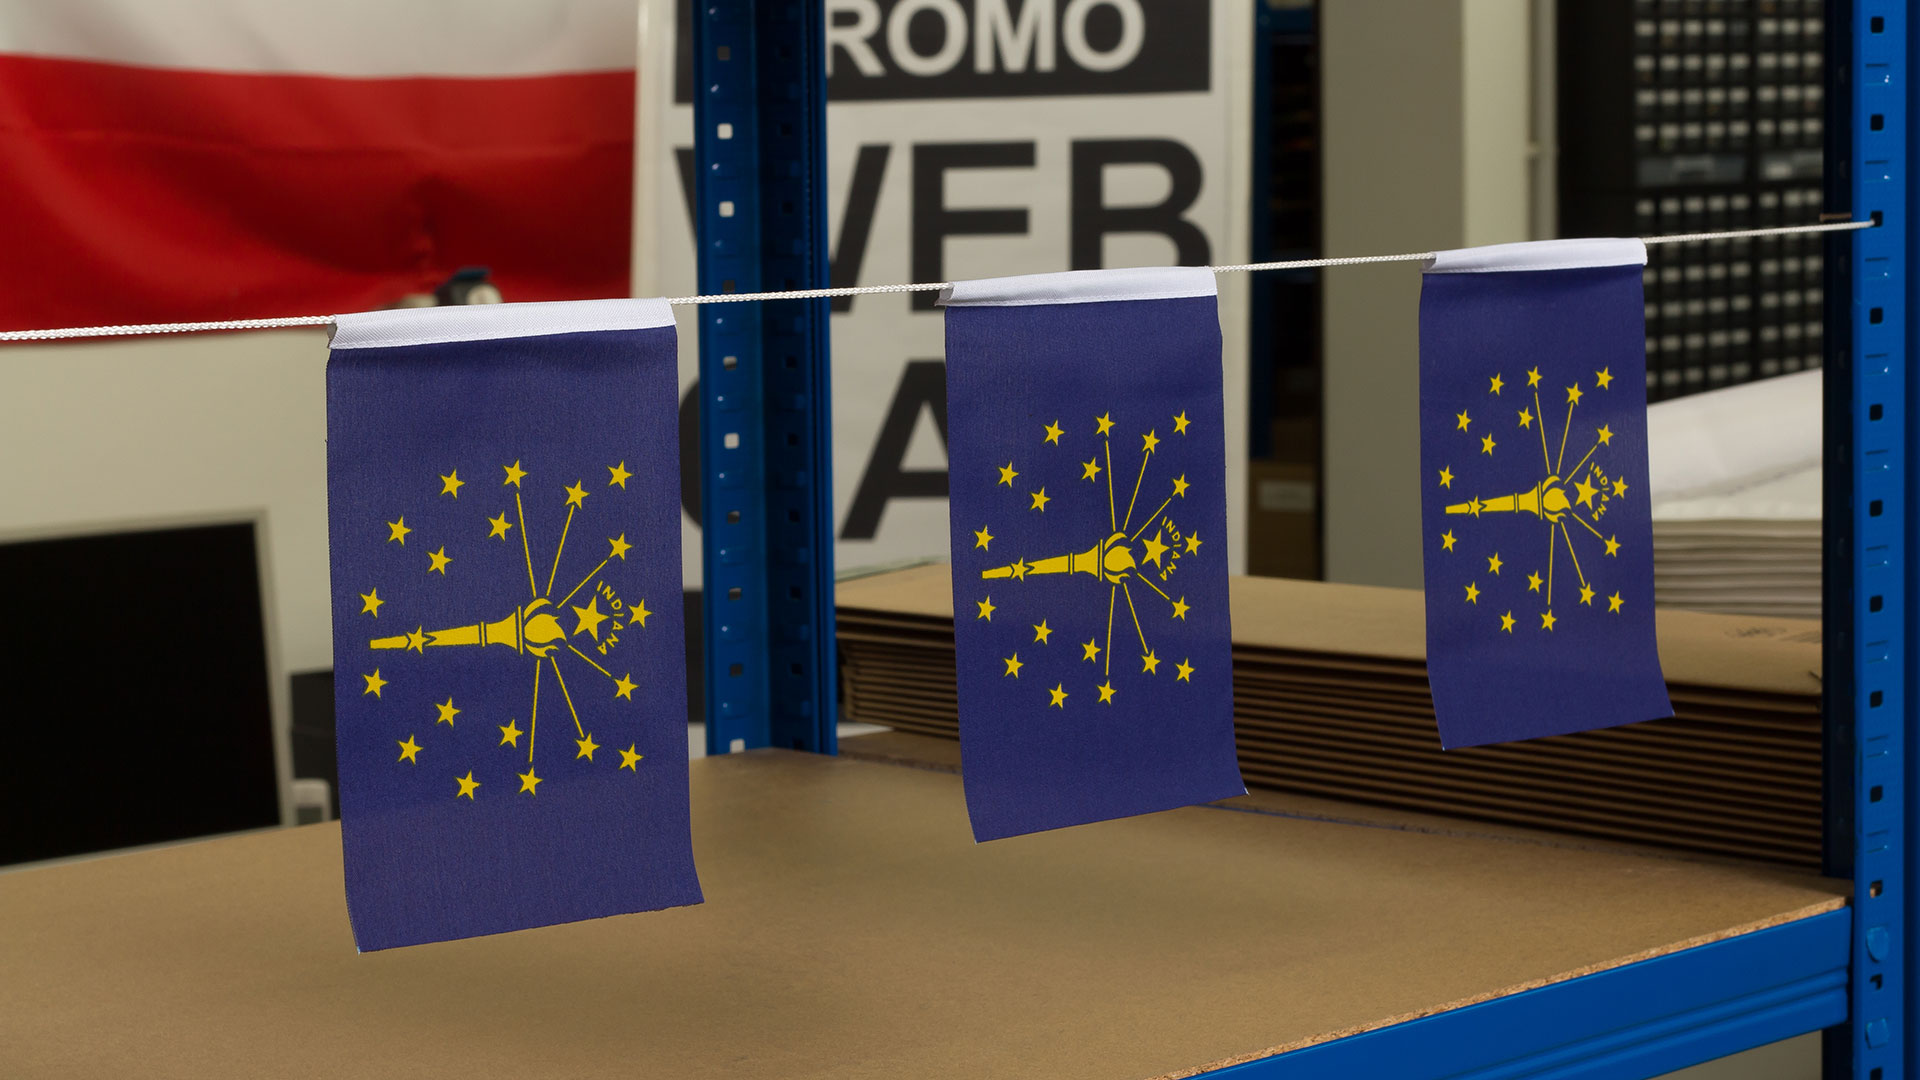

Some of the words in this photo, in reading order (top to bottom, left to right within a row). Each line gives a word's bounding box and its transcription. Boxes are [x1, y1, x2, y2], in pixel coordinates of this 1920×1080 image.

[826, 0, 1146, 77] ROMO
[1591, 461, 1610, 521] INDIANA
[1160, 515, 1182, 581] INDIANA
[596, 580, 625, 655] INDIANA
